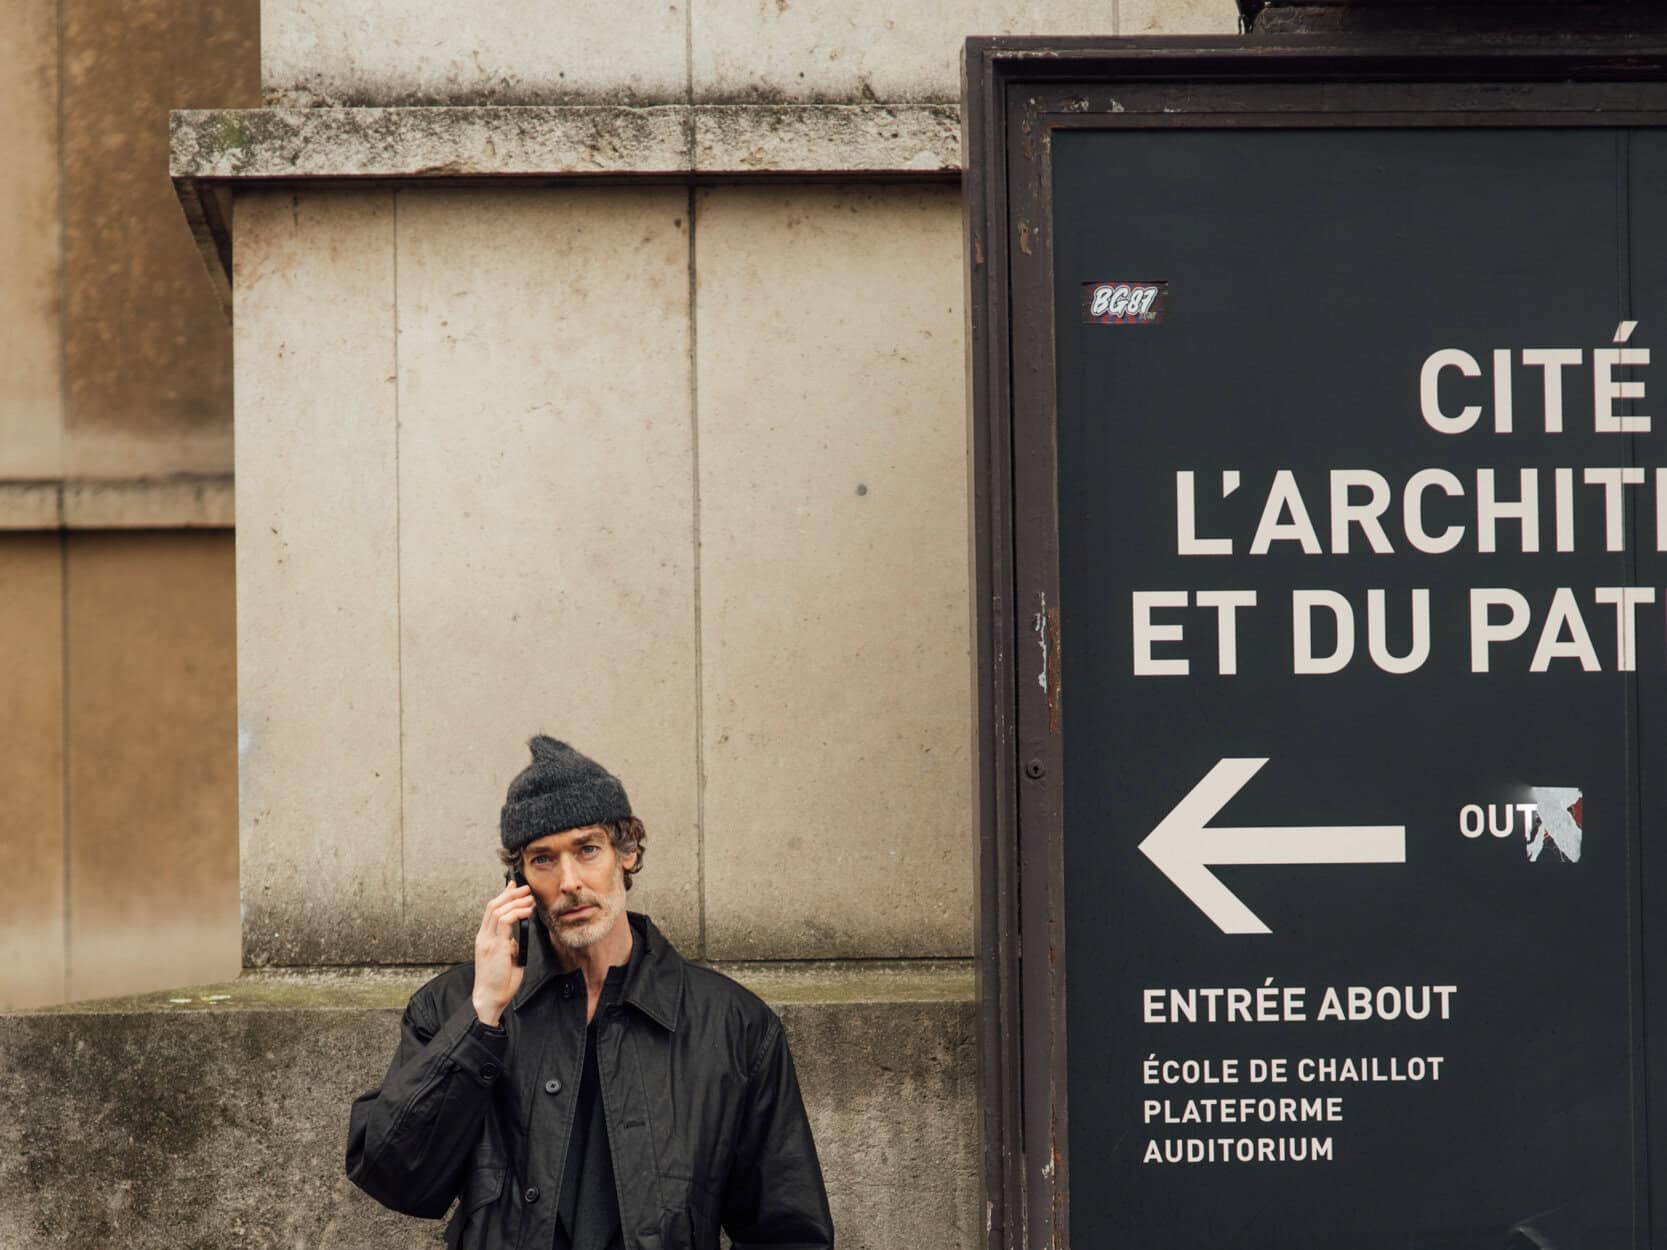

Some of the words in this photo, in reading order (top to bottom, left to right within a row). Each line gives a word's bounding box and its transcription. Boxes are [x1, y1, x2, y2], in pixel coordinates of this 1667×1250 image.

[1091, 285, 1158, 318] BG87
[1420, 320, 1652, 434] CITÉ
[1176, 467, 1667, 556] L’ARCHIT
[1132, 590, 1257, 676] ET
[1292, 588, 1431, 675] DU
[1469, 586, 1667, 673] PAT
[1143, 976, 1307, 1023] ENTRÉE
[1317, 985, 1458, 1021] ABOUT
[1143, 1053, 1239, 1084] ÉCOLE
[1249, 1059, 1288, 1083] DE
[1298, 1056, 1444, 1082] CHAILLOT
[1144, 1097, 1343, 1124] PLATEFORME
[1143, 1137, 1333, 1163] AUDITORIUM
